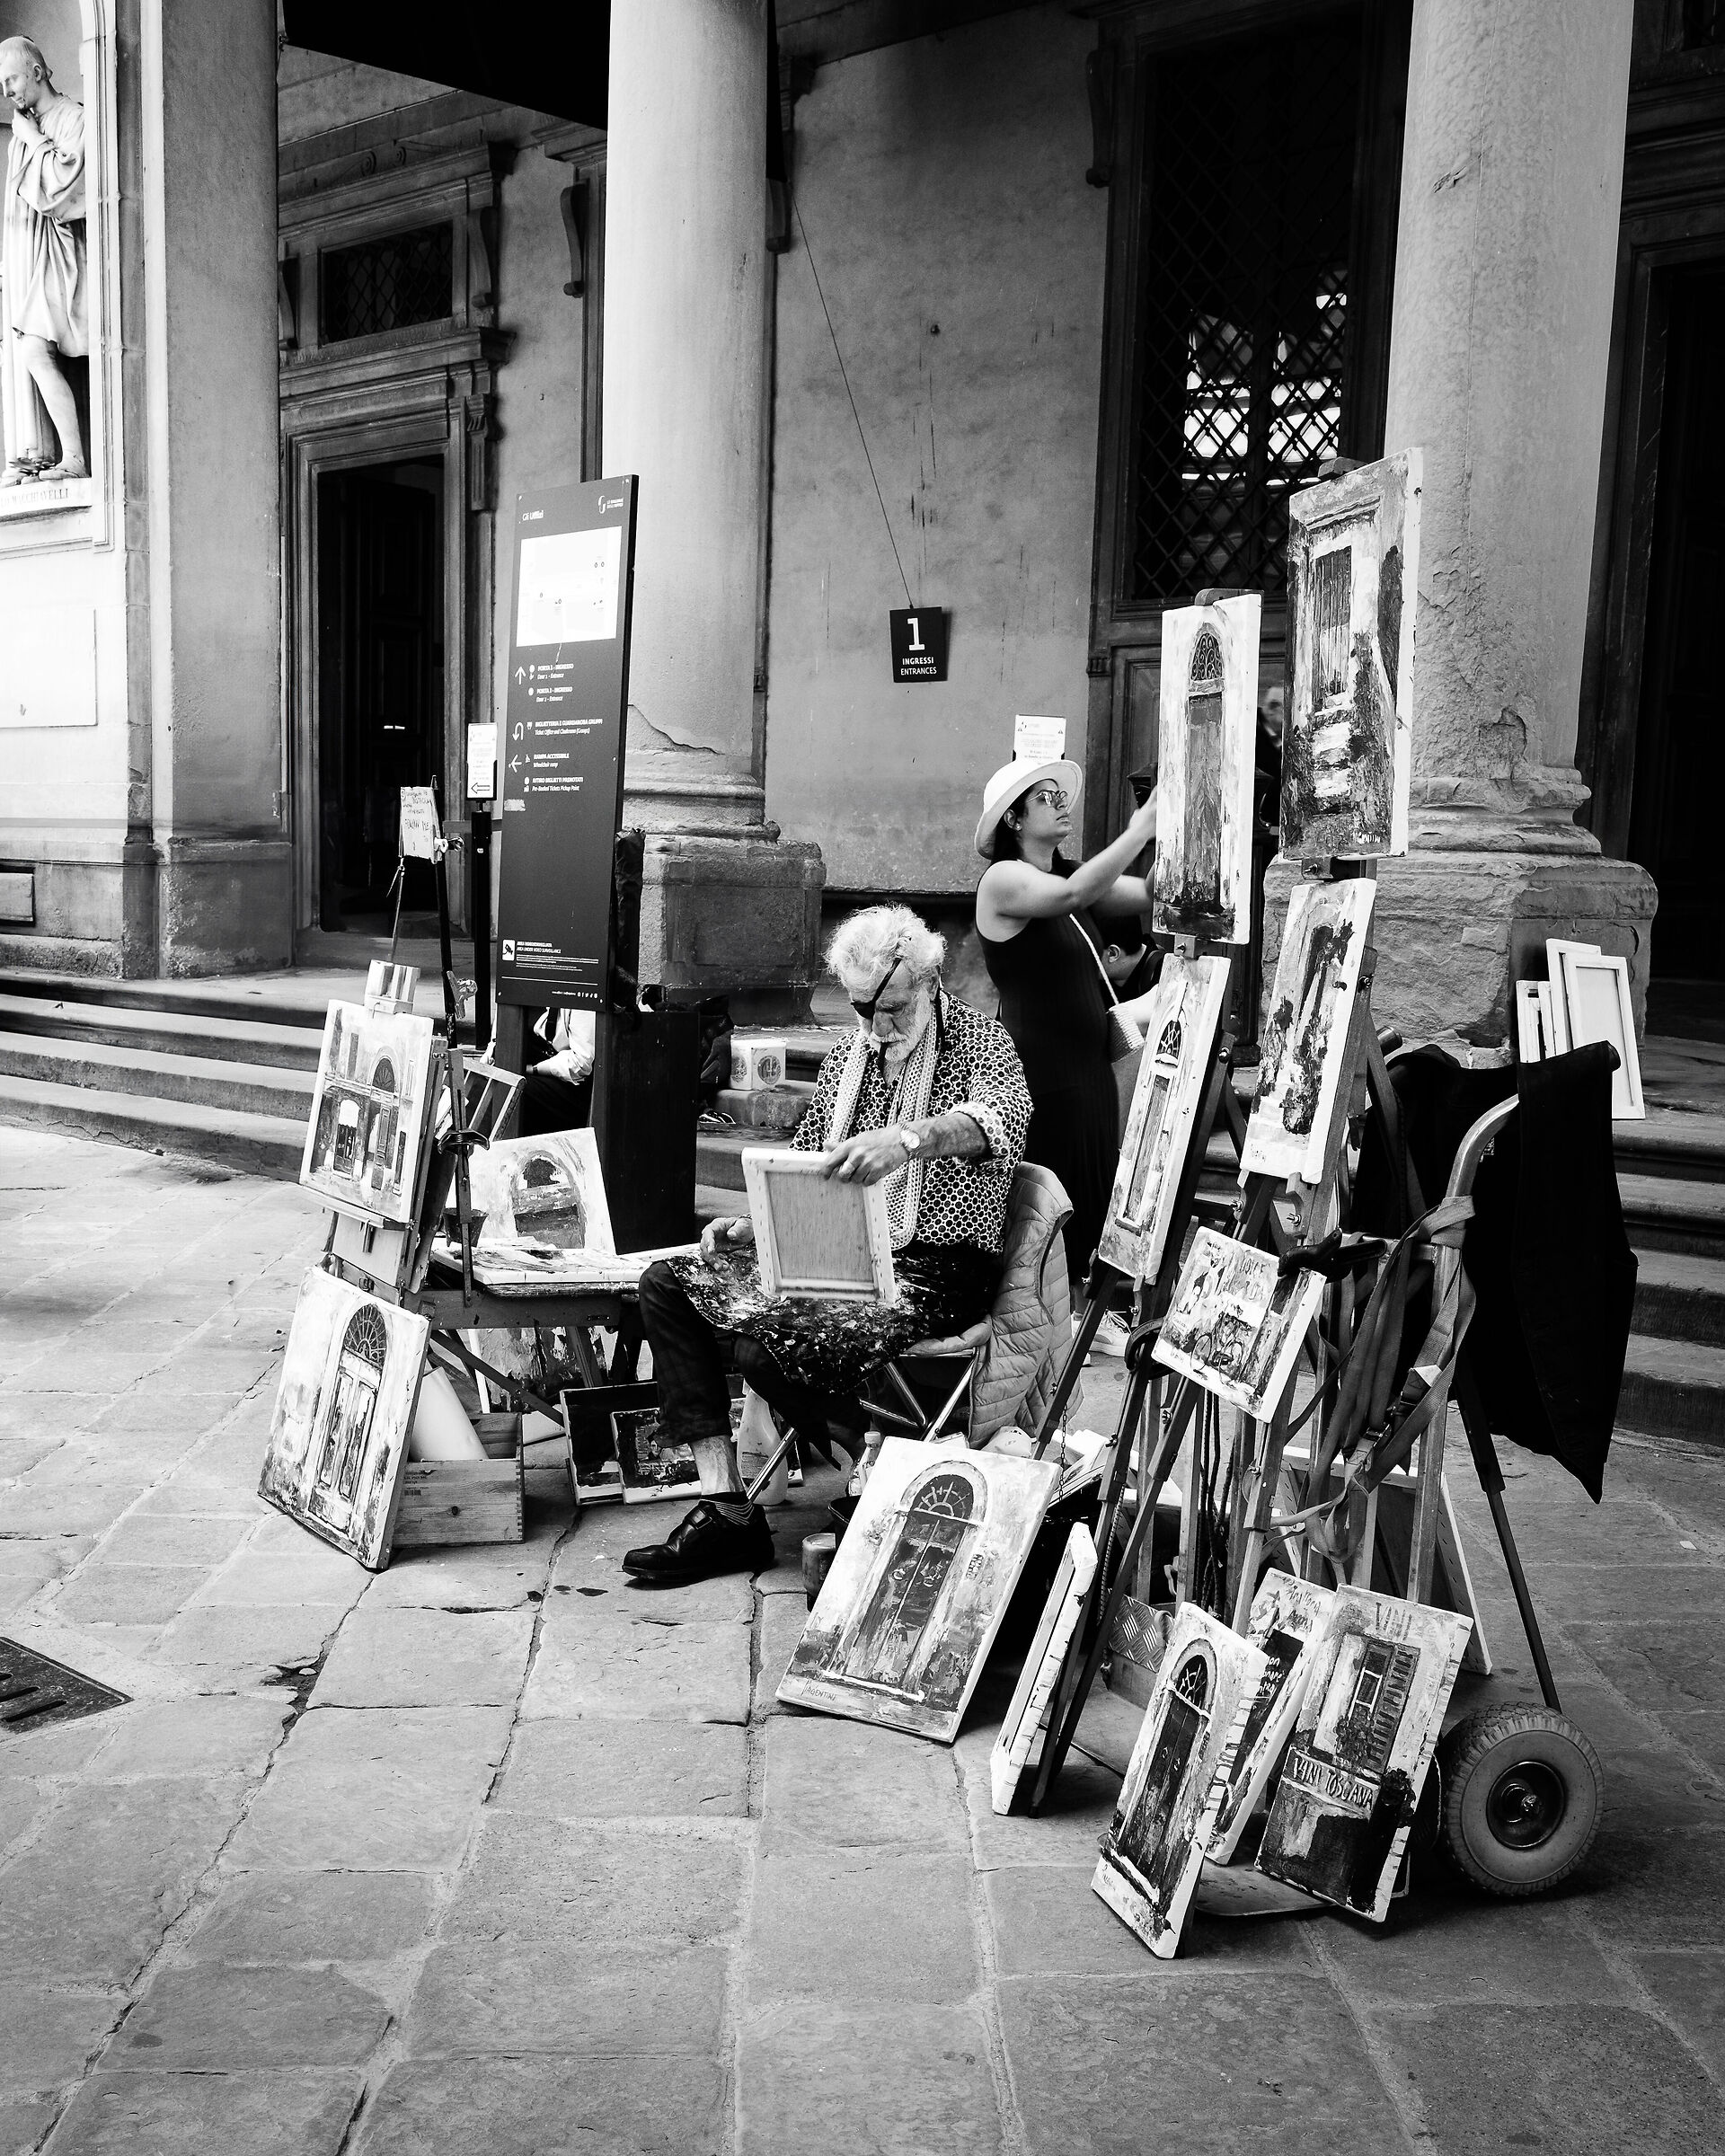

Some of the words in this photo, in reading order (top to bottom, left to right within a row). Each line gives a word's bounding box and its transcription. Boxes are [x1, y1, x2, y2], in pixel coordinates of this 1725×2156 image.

[907, 617, 925, 651] 1
[900, 667, 937, 676] ENTRANCES
[902, 657, 934, 666] INGRESSI
[1293, 1757, 1322, 1784] VINI
[1324, 1767, 1373, 1809] TOSCANA
